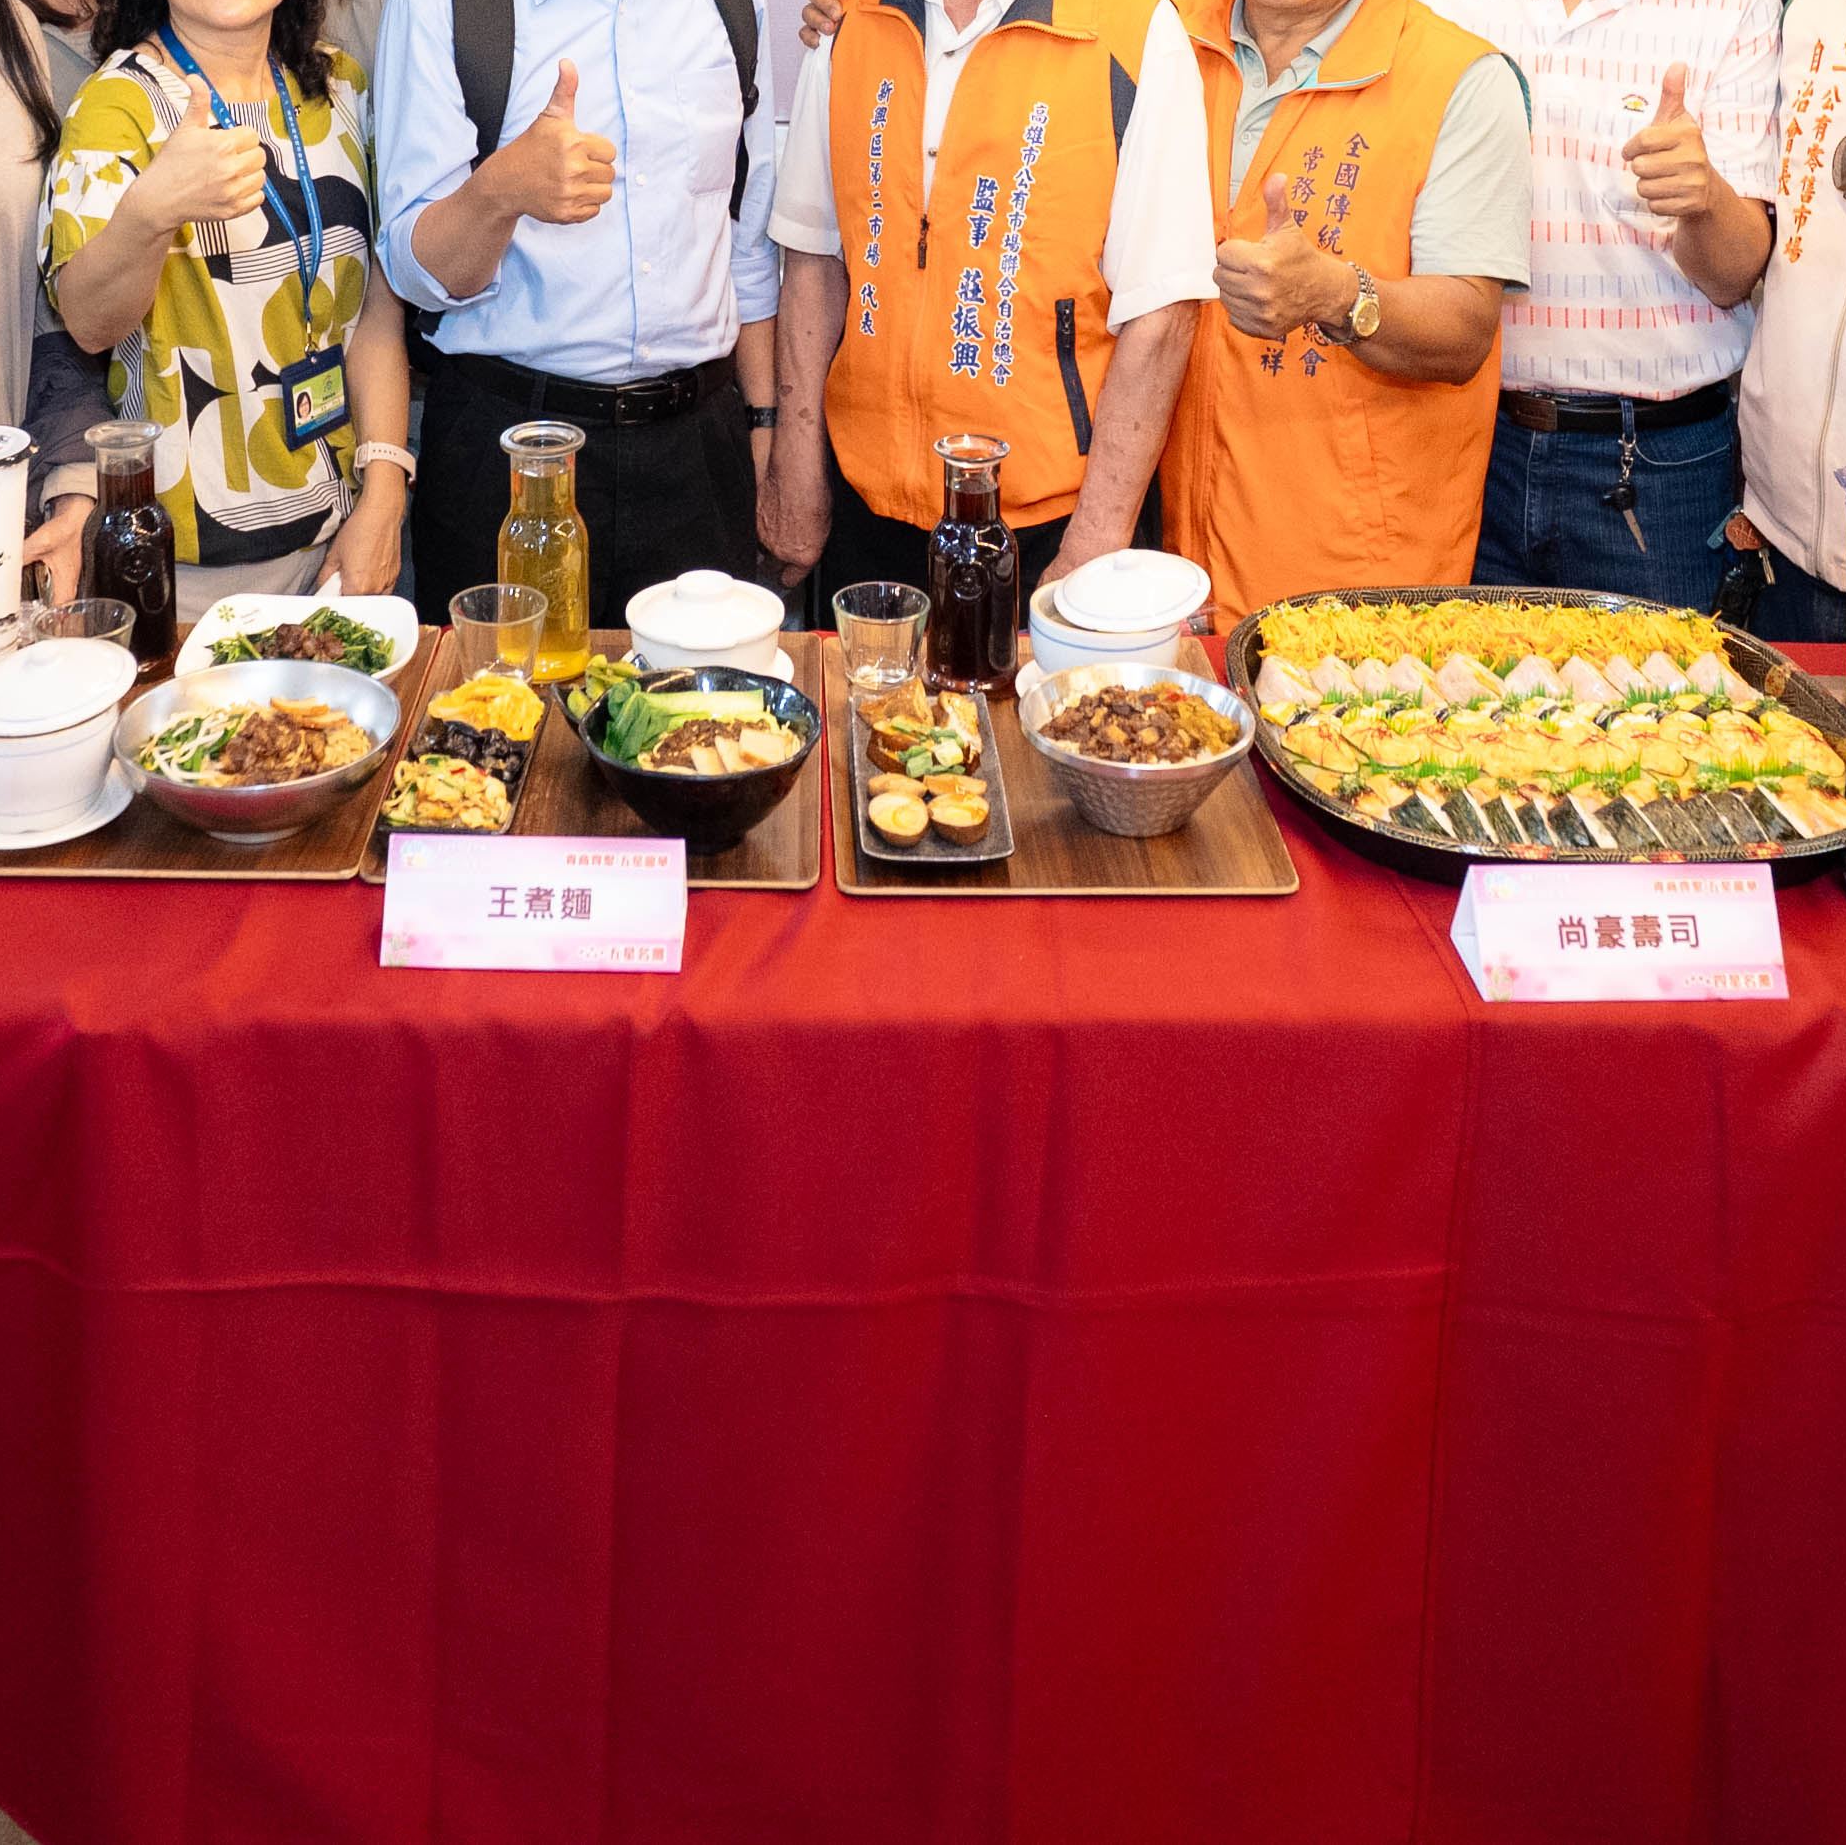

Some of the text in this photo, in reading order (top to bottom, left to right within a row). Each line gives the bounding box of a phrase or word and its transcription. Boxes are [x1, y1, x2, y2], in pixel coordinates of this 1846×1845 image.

[859, 79, 893, 336] 新興區第二市場 代表
[948, 176, 1000, 377] 監事 莊振興
[992, 104, 1049, 386] 高雄市公有市場聯合自治總會
[487, 886, 592, 921] 王煮麵
[1558, 914, 1699, 950] 尚豪壽司
